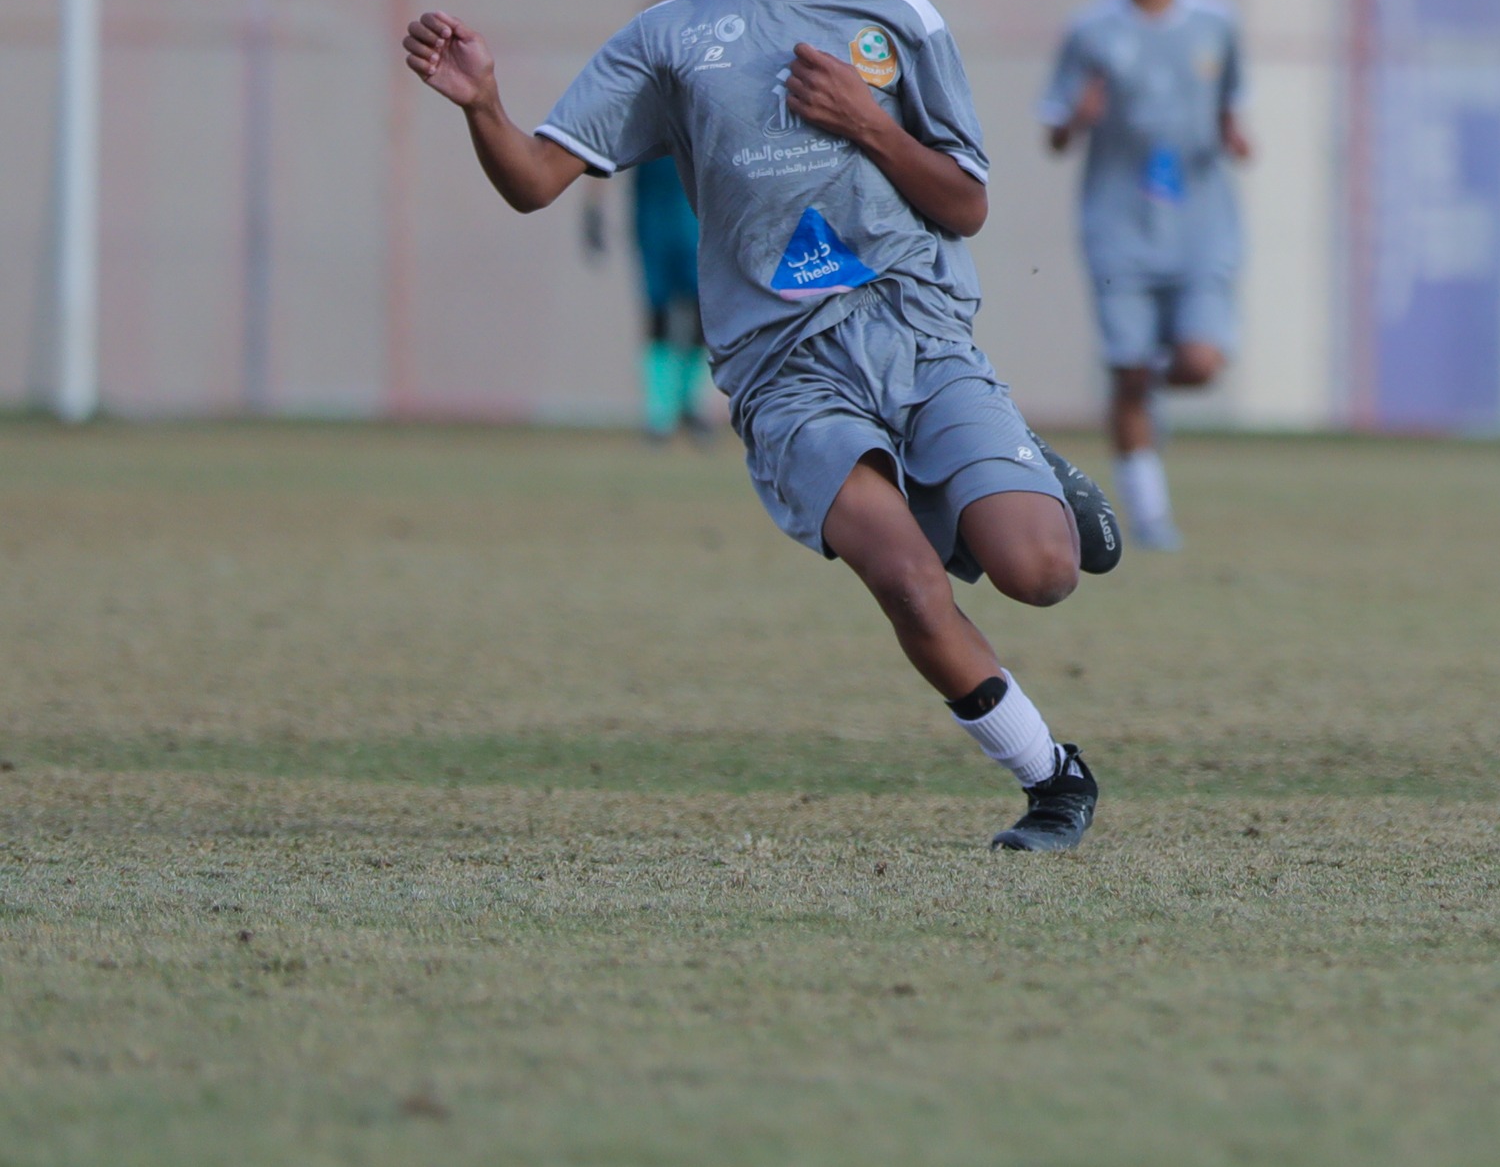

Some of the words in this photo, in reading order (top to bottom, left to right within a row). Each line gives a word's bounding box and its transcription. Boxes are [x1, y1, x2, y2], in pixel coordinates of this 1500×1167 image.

[732, 145, 772, 166] السلام
[773, 140, 808, 161] نجوم
[787, 240, 831, 270] ذيب
[792, 259, 840, 285] Theeb
